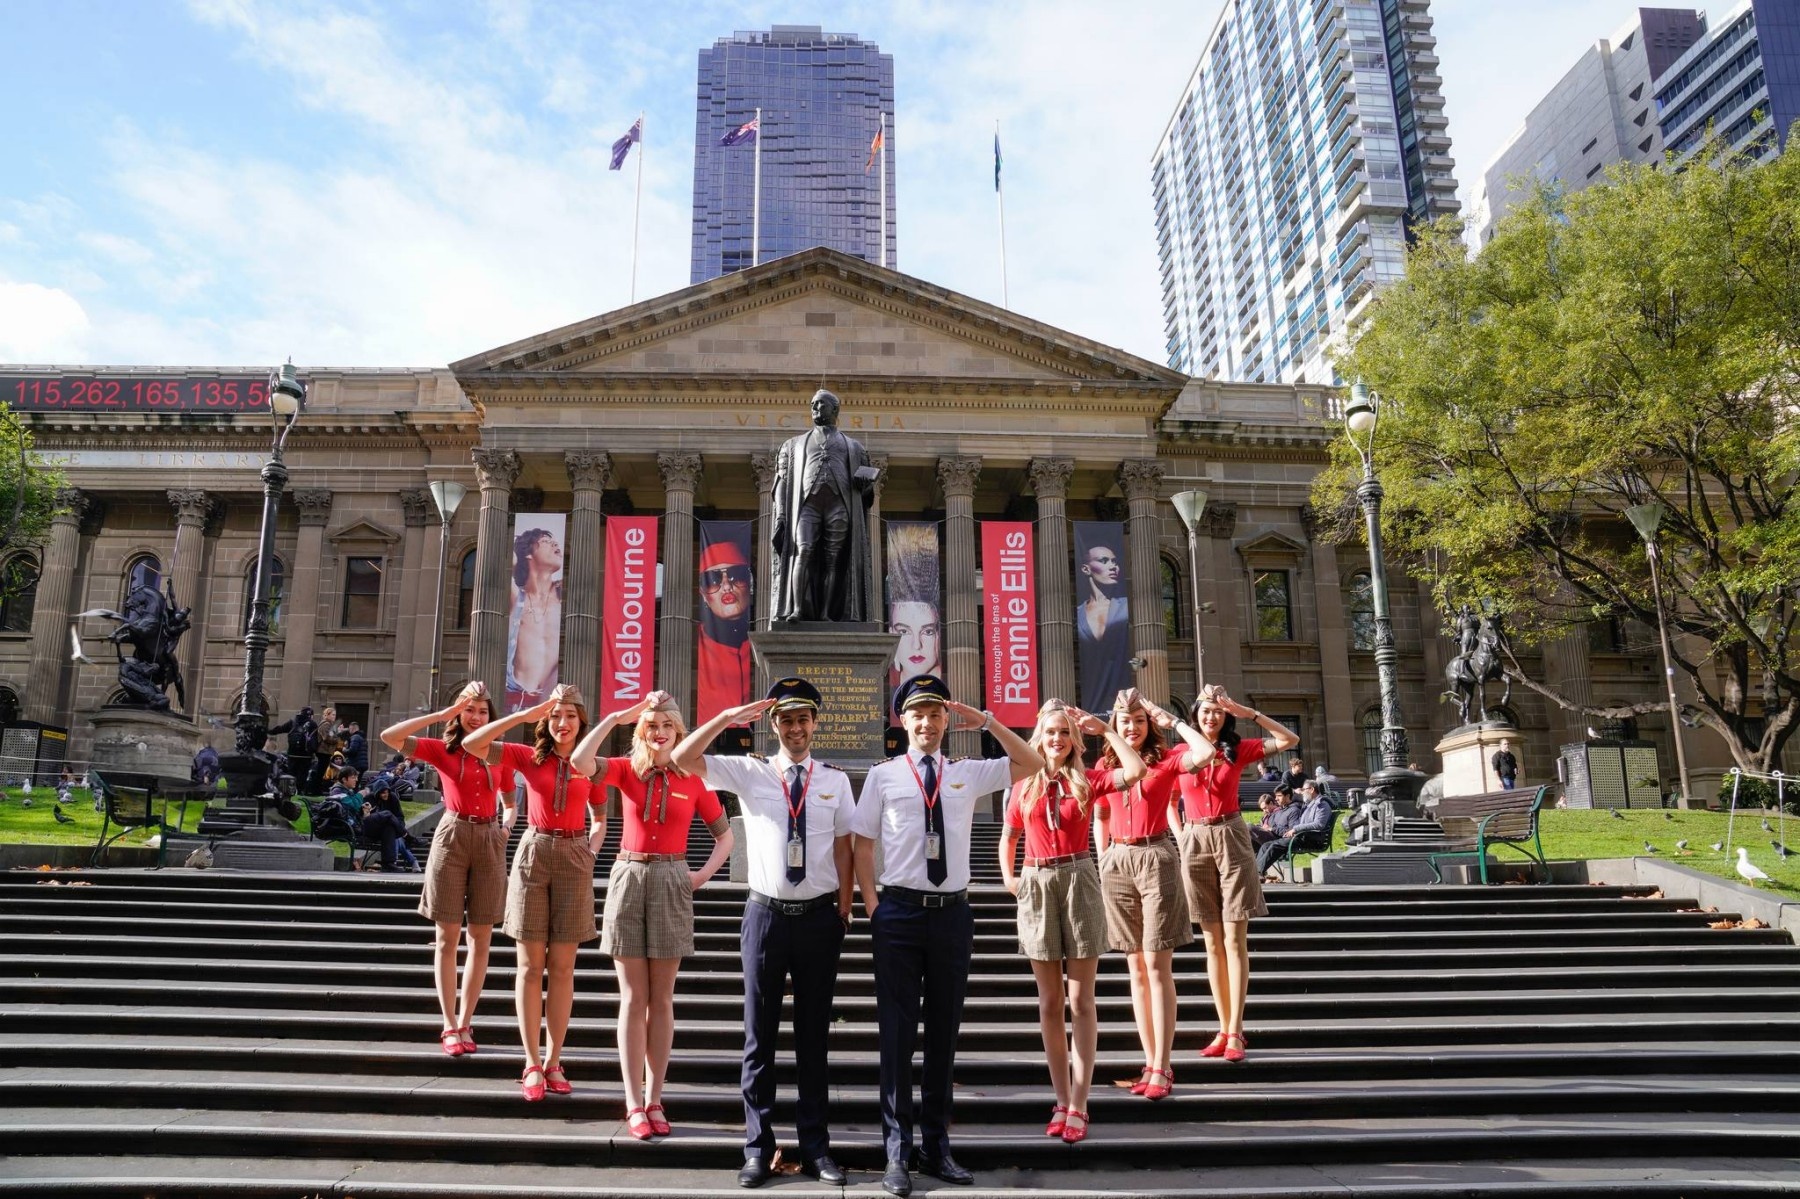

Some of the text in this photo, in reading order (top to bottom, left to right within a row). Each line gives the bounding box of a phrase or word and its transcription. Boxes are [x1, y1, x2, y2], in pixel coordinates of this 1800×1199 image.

[735, 414, 905, 429] VICTRIA
[614, 527, 645, 700] Melbourne
[991, 593, 1003, 703] Life through the lens of
[999, 532, 1031, 704] Rennie Ellis
[796, 666, 853, 675] ERECTED
